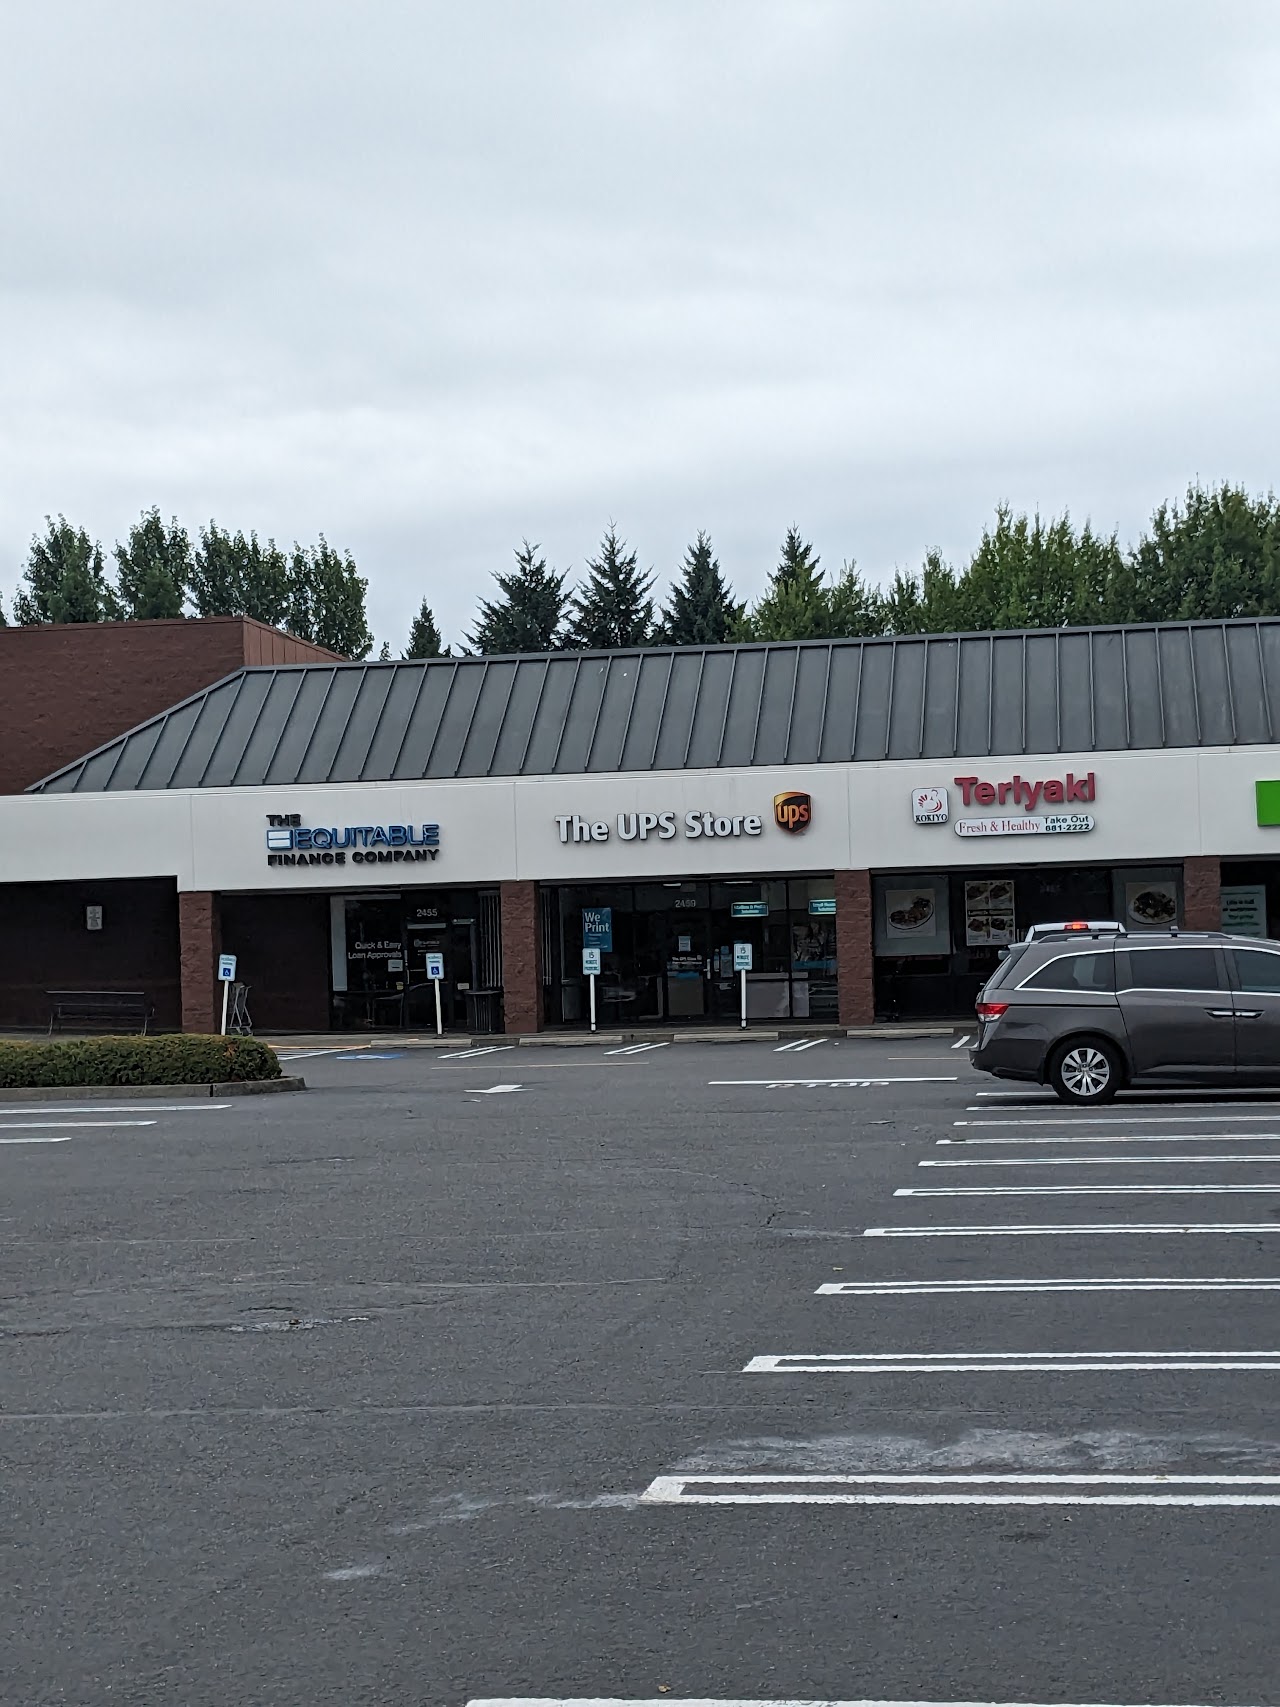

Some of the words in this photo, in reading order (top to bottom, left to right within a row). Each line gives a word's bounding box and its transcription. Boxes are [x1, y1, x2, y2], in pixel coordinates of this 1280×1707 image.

[266, 814, 302, 827] THE
[777, 804, 809, 829] ups
[915, 813, 948, 822] KOKIYO
[1044, 816, 1068, 824] Take
[1070, 815, 1089, 823] Out
[555, 815, 609, 843] The
[617, 811, 676, 841] UPS
[685, 810, 763, 839] Store
[959, 821, 987, 833] Fresh
[990, 820, 998, 832] &
[1001, 819, 1041, 832] Healthy
[294, 824, 440, 850] EQUITABLE
[267, 852, 346, 867] FINANCE
[352, 849, 440, 864] COMPANY
[584, 912, 601, 922] We
[584, 922, 610, 933] Print
[355, 941, 376, 949] Quick
[348, 951, 366, 960] Loan
[367, 950, 403, 960] Approvals
